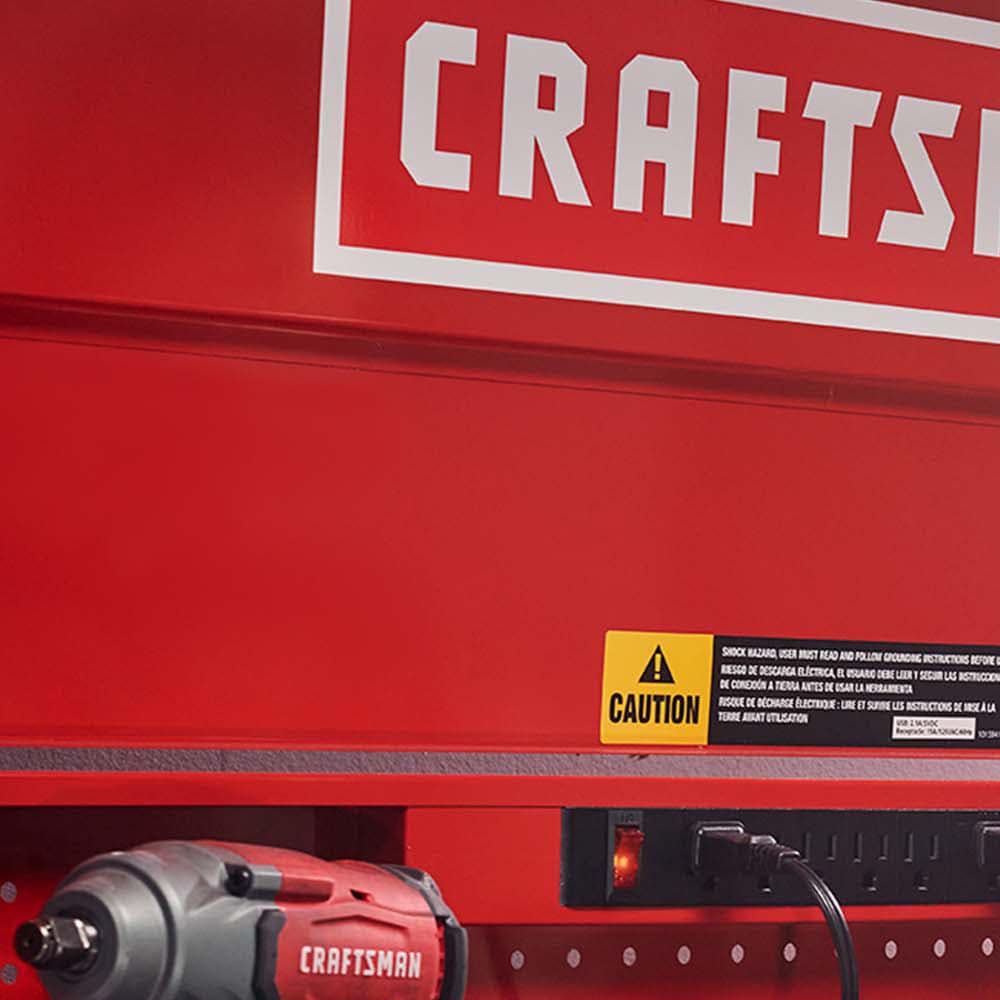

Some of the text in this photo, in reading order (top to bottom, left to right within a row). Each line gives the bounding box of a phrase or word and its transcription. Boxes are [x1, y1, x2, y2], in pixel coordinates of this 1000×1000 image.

[721, 646, 746, 657] SHOCK
[779, 649, 797, 659] USER
[799, 649, 818, 659] MUST
[819, 650, 839, 660] READ
[840, 651, 854, 661] AND
[855, 651, 882, 662] FOLLOW
[923, 654, 969, 665] INSTRUCTIONS
[970, 655, 995, 665] BEFORE
[721, 664, 747, 675] RIESGO
[748, 665, 758, 676] DE
[759, 665, 796, 677] DESCARGA
[944, 671, 957, 681] LAS
[720, 679, 730, 690] DE
[768, 680, 774, 690] A
[801, 681, 824, 692] ANTES
[824, 682, 834, 692] DE
[835, 682, 854, 692] USAR
[855, 683, 865, 693] LA
[609, 692, 700, 725] CAUTION
[746, 697, 756, 708] DE
[953, 702, 963, 712] DE
[300, 945, 421, 979] CRAFTSMAN
